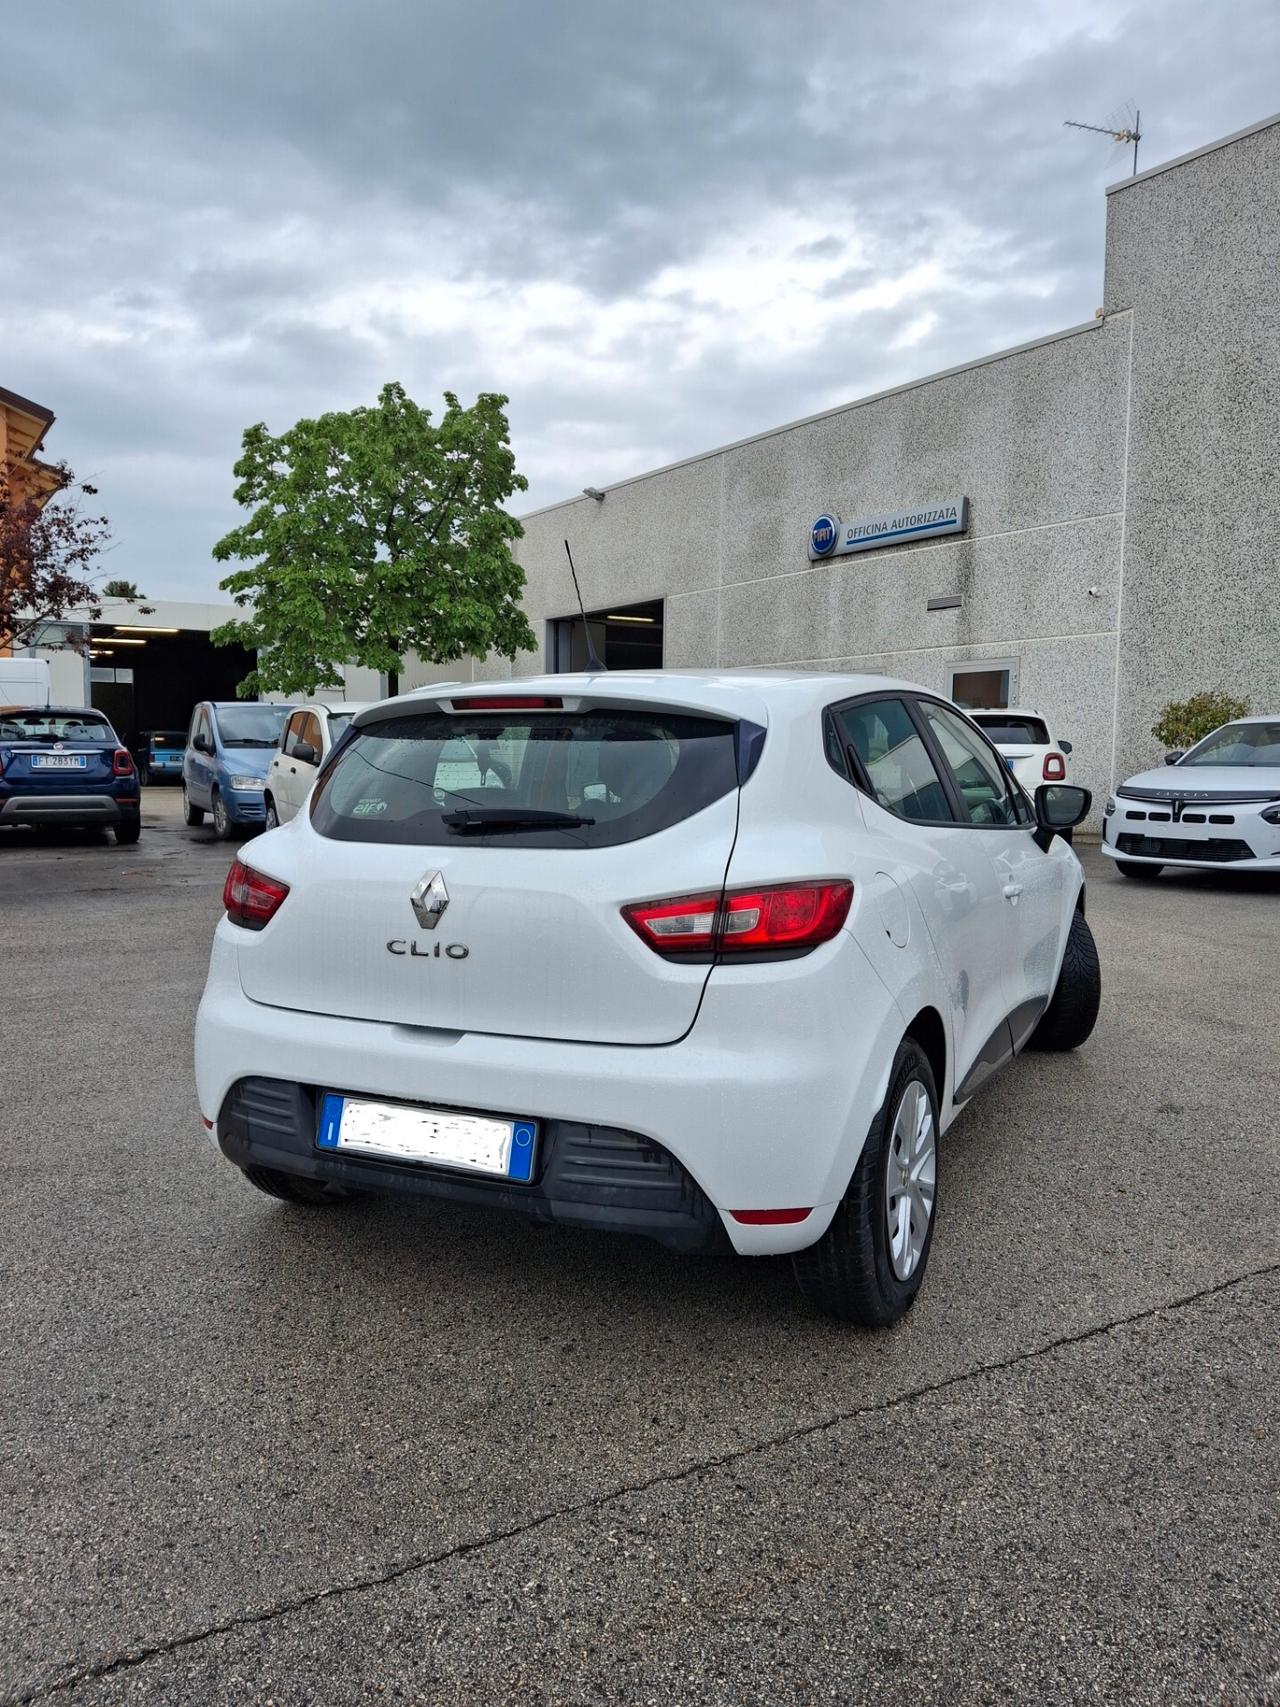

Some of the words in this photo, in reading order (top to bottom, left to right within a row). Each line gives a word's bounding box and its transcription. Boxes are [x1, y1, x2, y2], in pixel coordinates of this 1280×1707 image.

[847, 521, 888, 539] OFFICINA
[891, 506, 957, 529] AUTORIZZATA
[386, 938, 470, 960] CLIO
